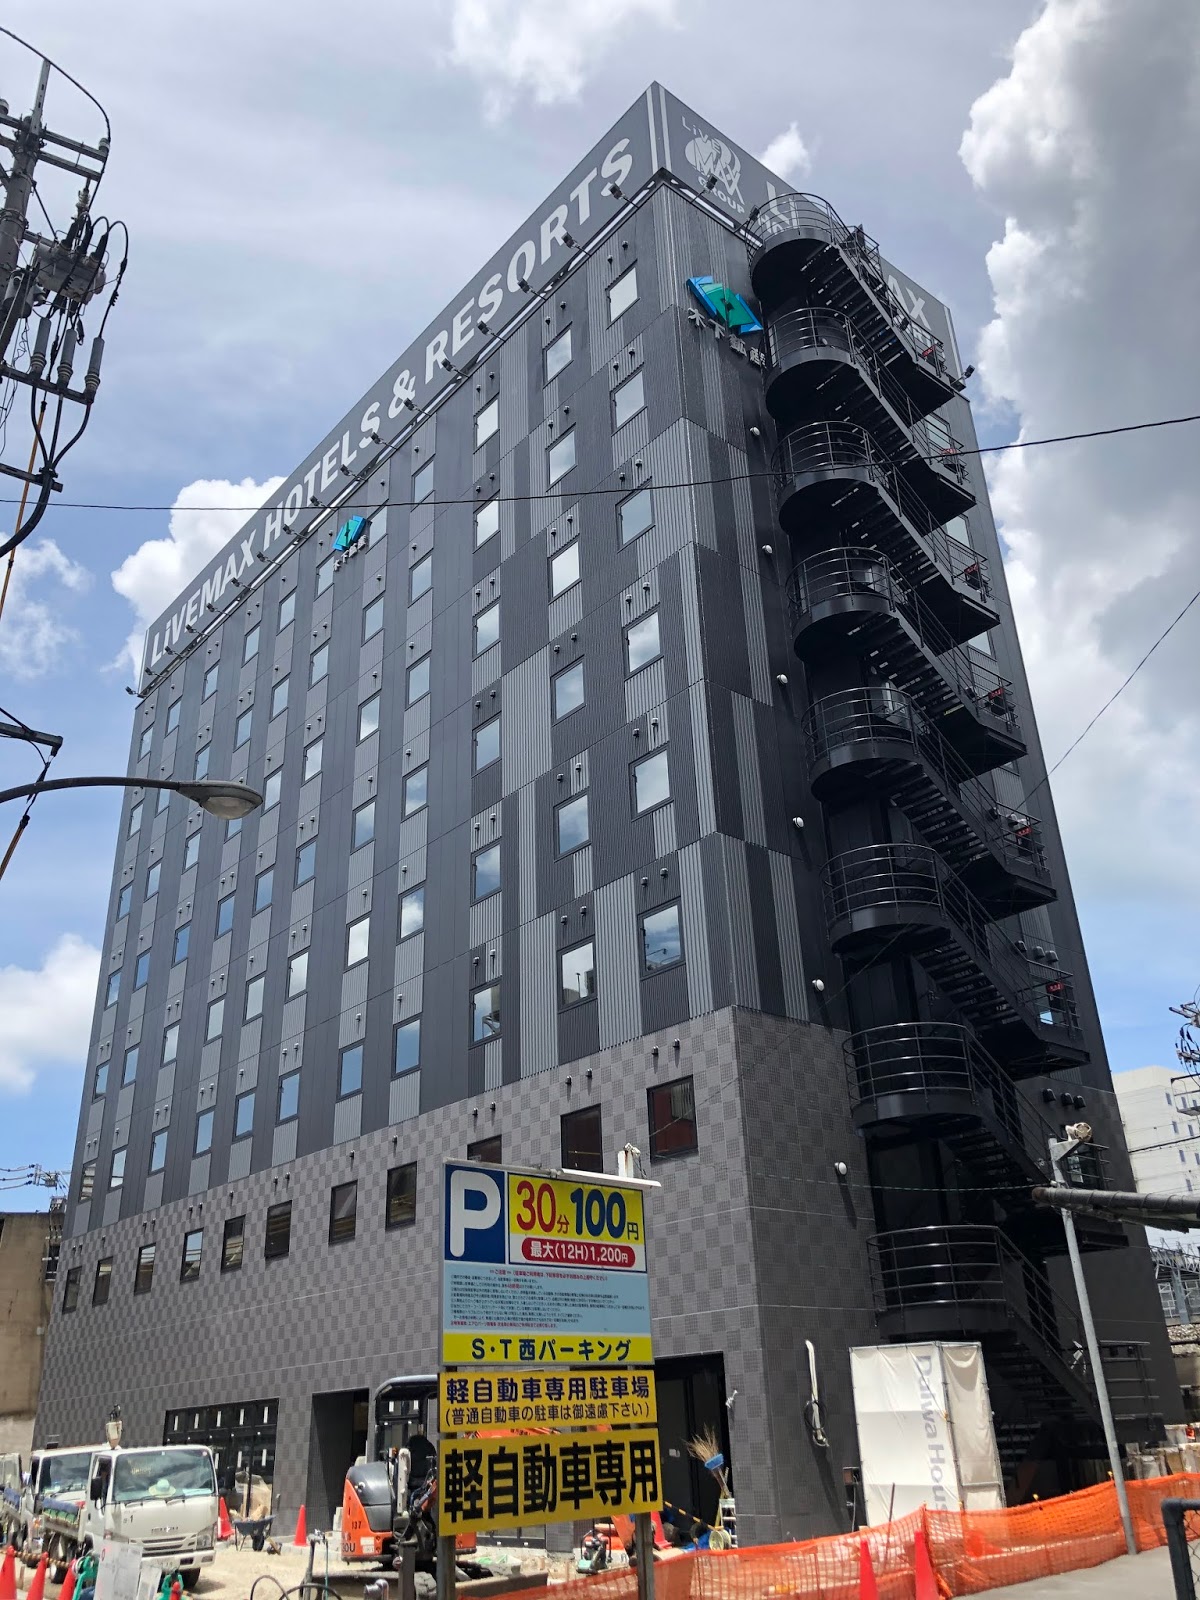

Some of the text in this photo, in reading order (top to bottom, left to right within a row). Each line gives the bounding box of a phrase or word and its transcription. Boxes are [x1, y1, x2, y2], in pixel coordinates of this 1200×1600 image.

[263, 401, 381, 552] HOTELS
[388, 369, 416, 418] &
[425, 138, 633, 384] RESORTS
[449, 1169, 501, 1258] P
[446, 1376, 650, 1405] 軽自動車専用駐車場
[446, 1402, 650, 1427] (普通自動車の駐車は御遠慮下さい)
[444, 1440, 659, 1523] 軽自動車専用
